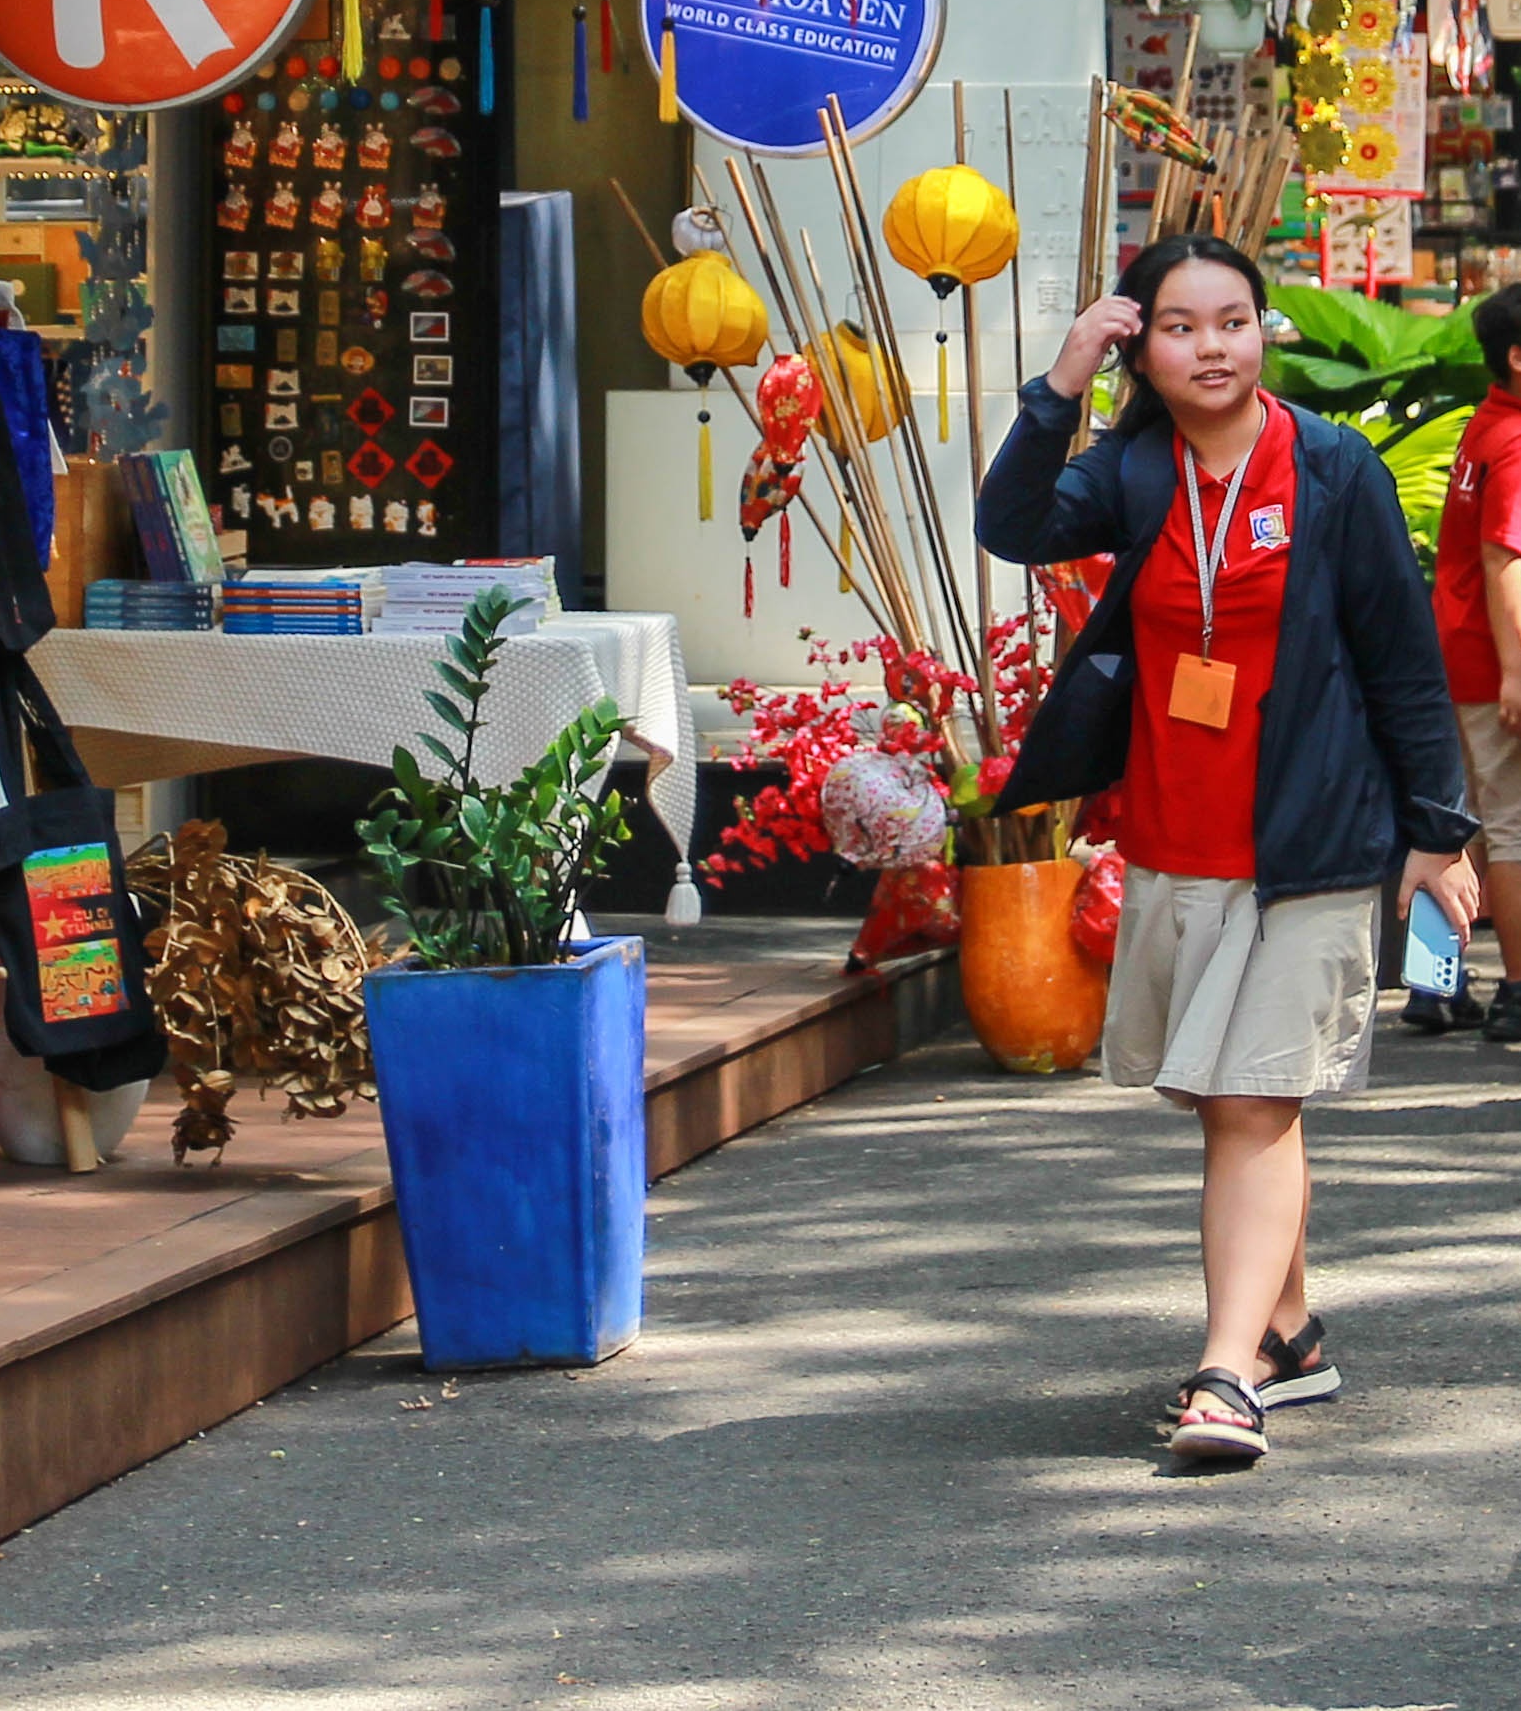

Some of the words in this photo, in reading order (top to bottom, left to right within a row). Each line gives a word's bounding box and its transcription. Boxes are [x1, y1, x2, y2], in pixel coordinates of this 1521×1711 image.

[667, 1, 729, 29] WORLD
[734, 15, 790, 40] CLASS
[793, 28, 897, 62] EDUCATION
